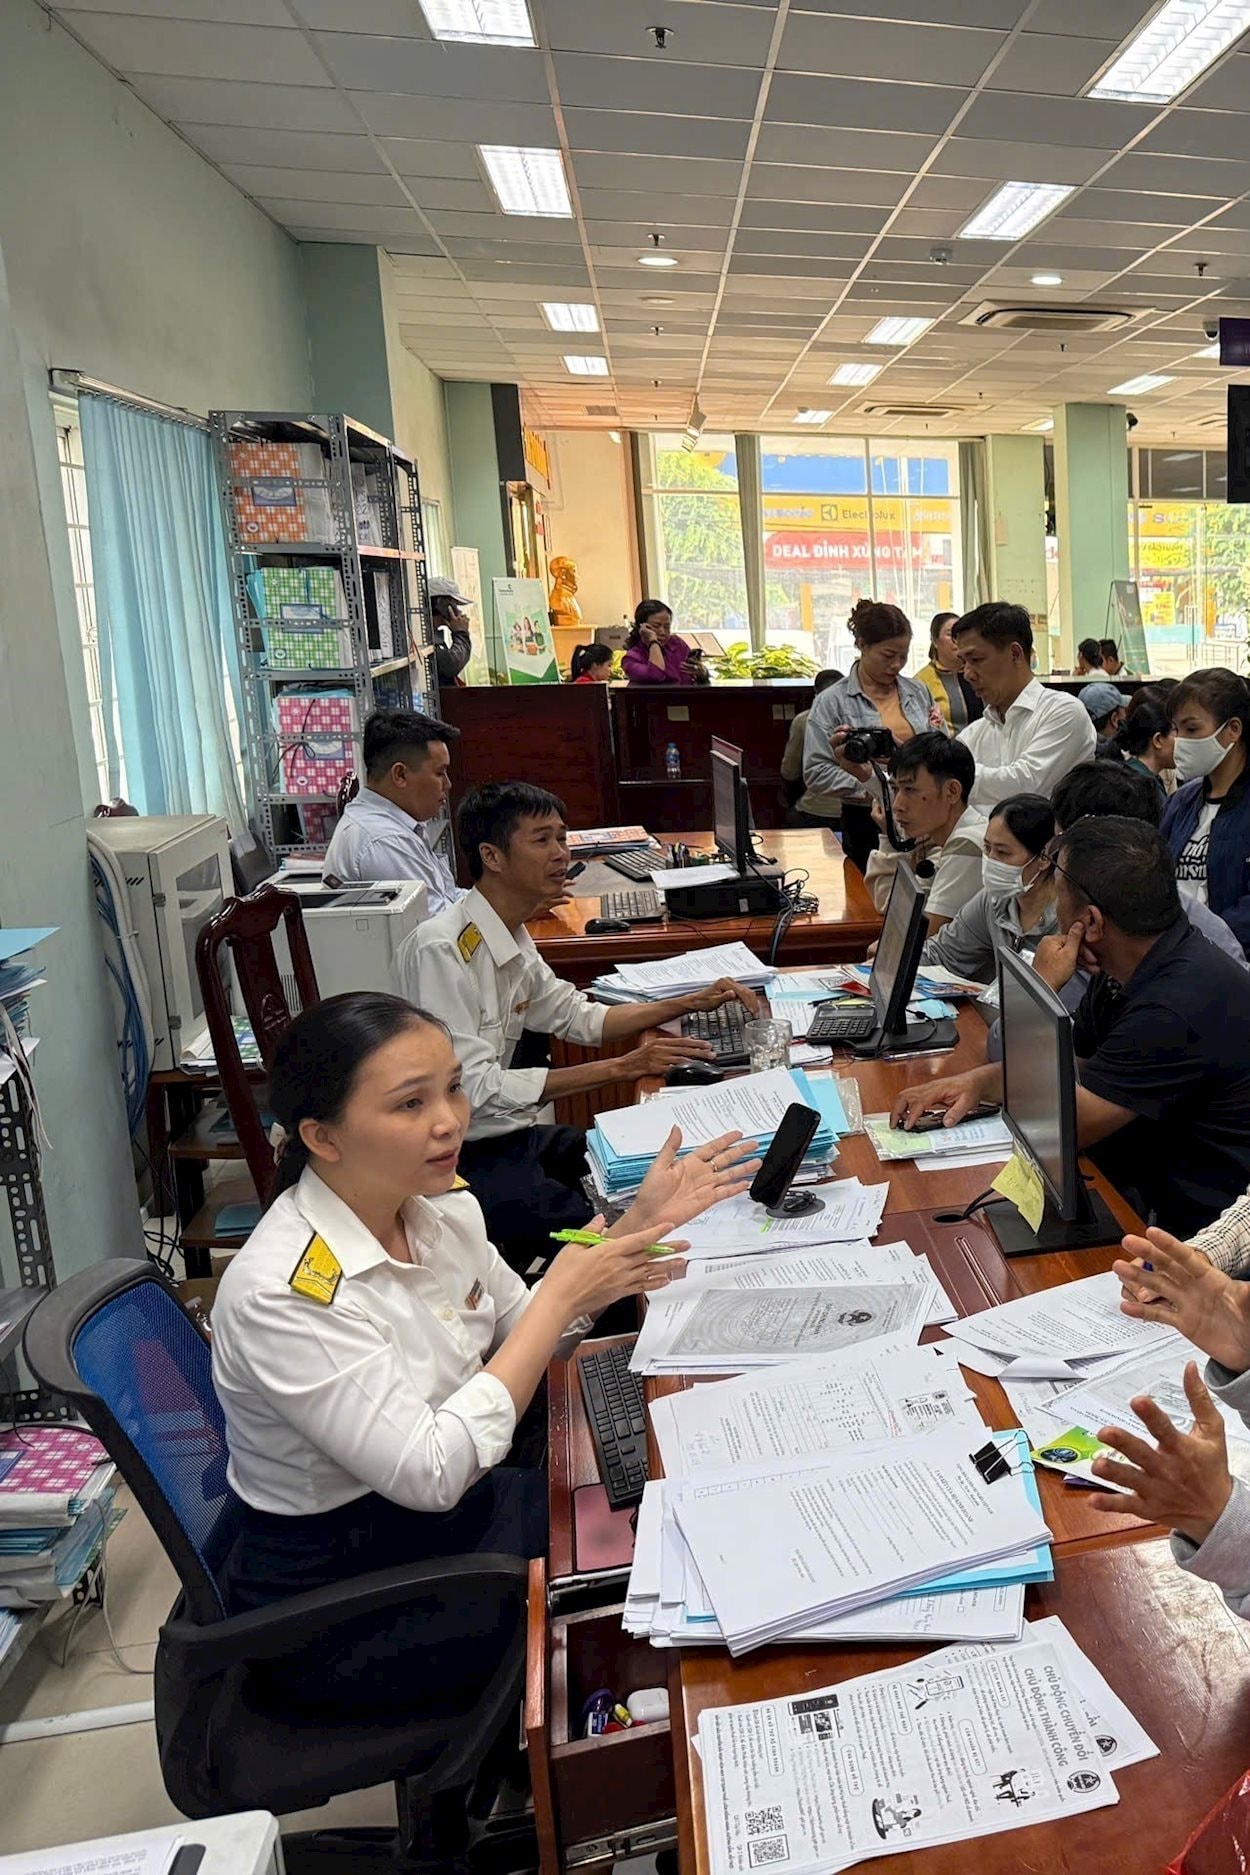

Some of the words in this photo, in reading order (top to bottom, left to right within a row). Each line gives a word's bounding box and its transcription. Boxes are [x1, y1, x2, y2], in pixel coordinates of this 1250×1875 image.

[773, 544, 810, 557] DEAL
[813, 539, 848, 557] ĐỈNH
[1024, 1668, 1042, 1686] CHỦ
[1044, 1665, 1061, 1683] CHỦ
[1030, 1686, 1047, 1712] ĐỘNG
[1050, 1684, 1068, 1709] ĐỘNG
[1040, 1712, 1059, 1742] THÀNH
[1060, 1709, 1086, 1743] CHUYỂN
[1051, 1742, 1068, 1767] CÔNG
[1073, 1744, 1094, 1761] ĐỔI
